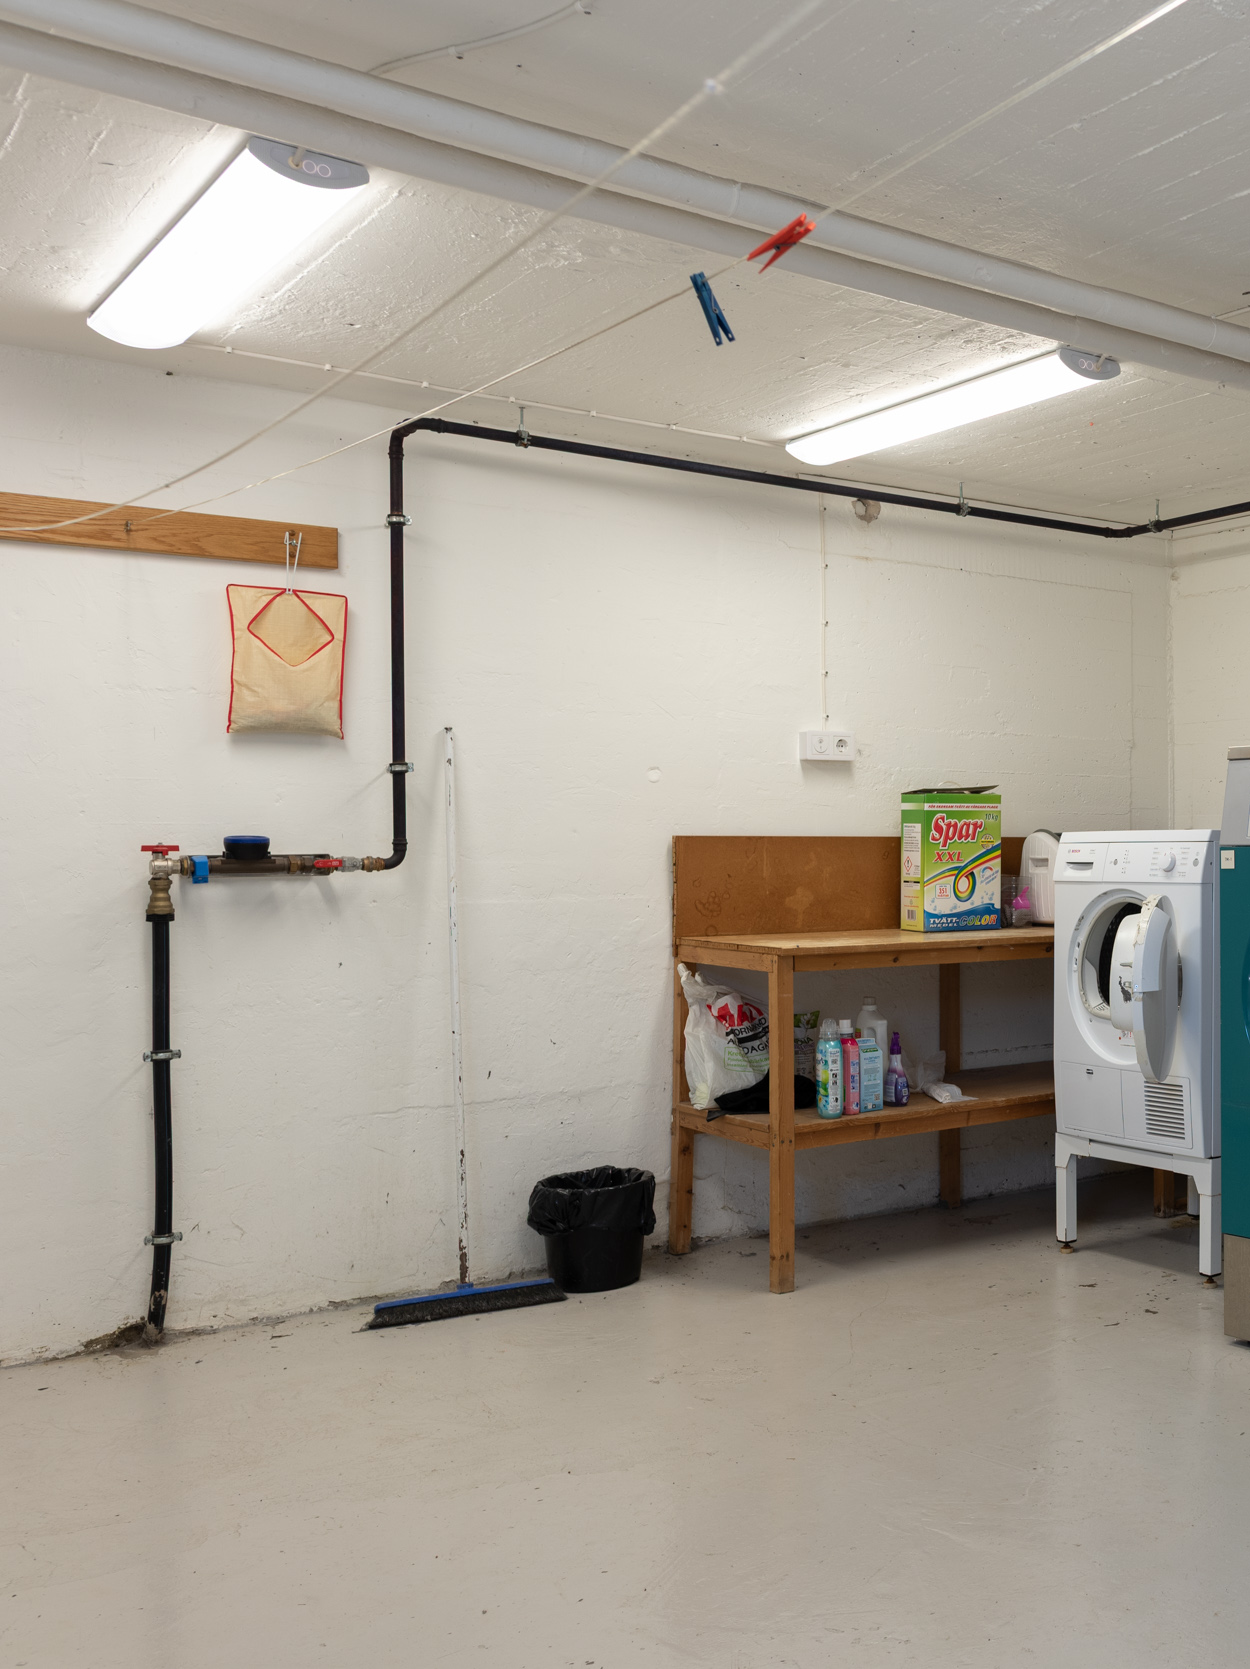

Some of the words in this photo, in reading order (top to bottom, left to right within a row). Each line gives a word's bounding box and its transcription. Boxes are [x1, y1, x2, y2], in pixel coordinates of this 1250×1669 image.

[930, 813, 984, 849] Spar
[933, 850, 964, 862] XXL
[929, 916, 959, 924] TVÄTT-
[959, 914, 998, 926] COLOR
